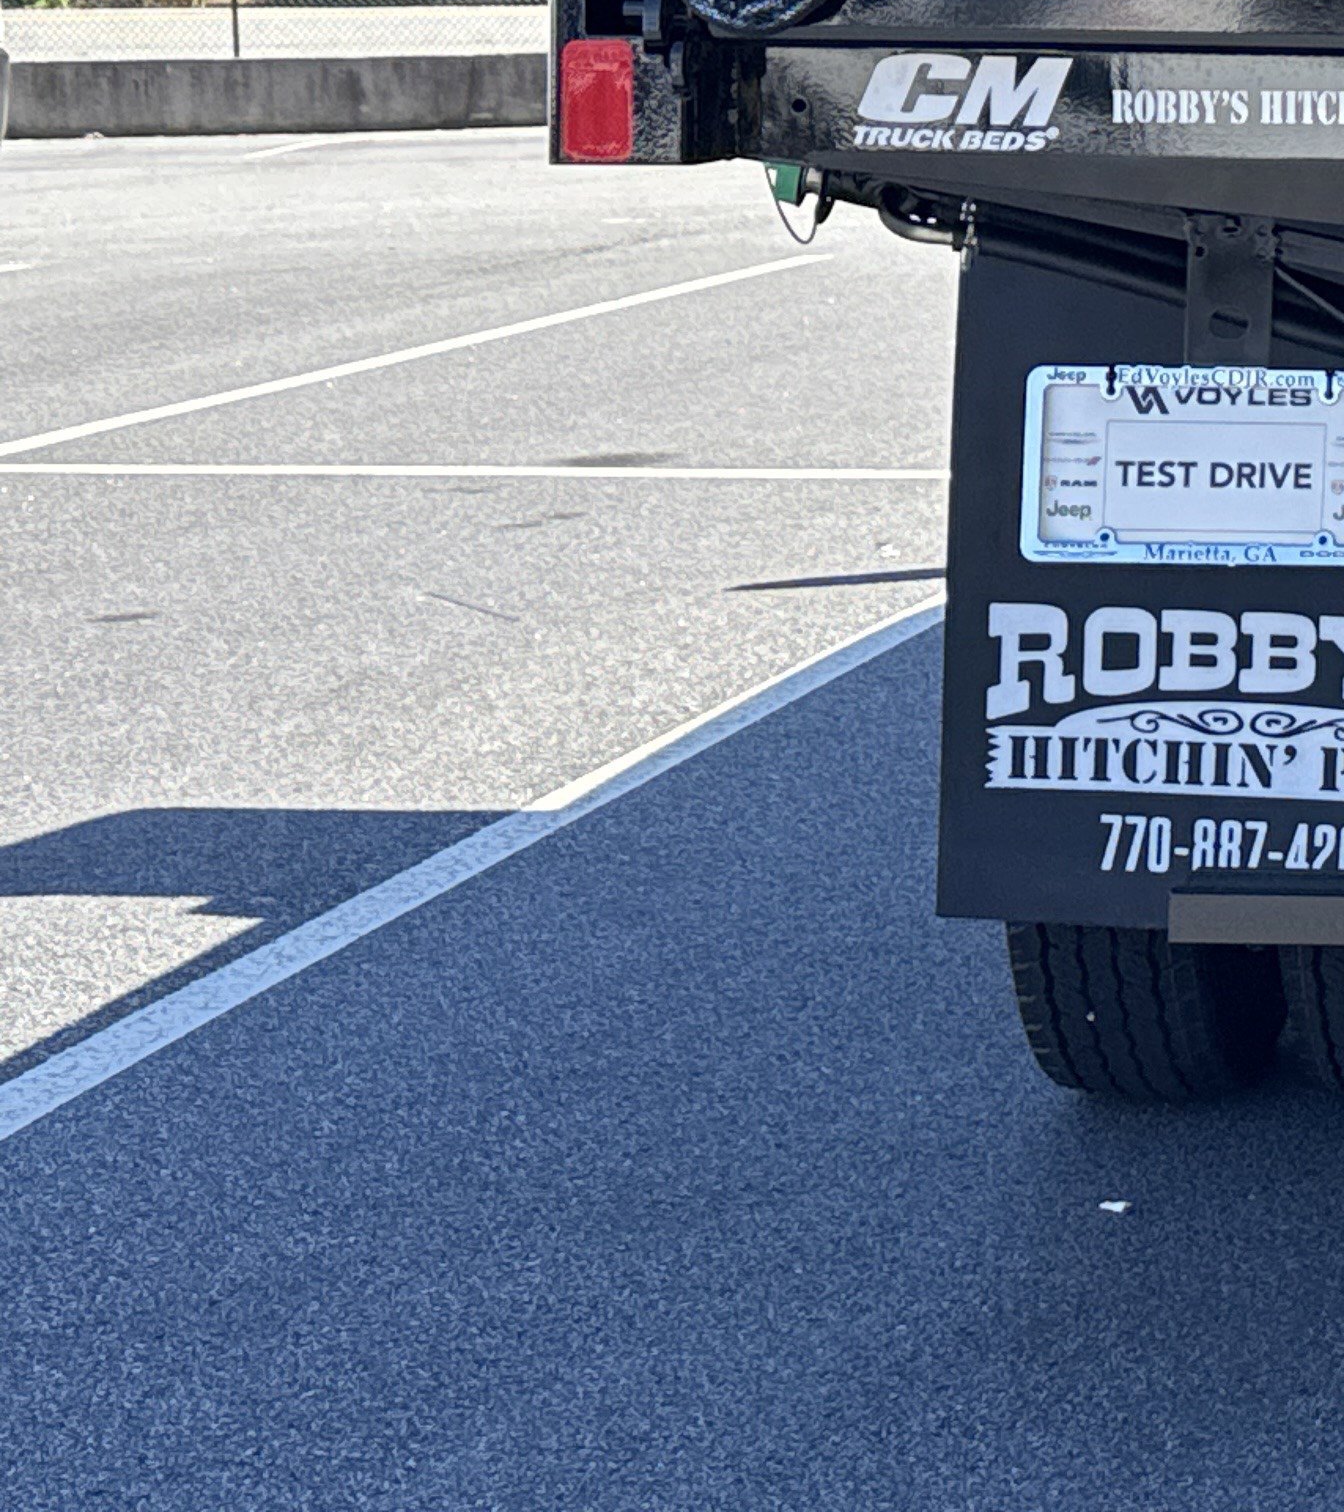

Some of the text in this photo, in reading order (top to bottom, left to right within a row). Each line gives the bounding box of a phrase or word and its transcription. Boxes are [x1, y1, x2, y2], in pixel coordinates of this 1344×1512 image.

[857, 53, 1073, 126] CM
[1112, 89, 1249, 124] ROBBY'S
[853, 125, 956, 149] TRUCK
[1046, 367, 1087, 384] Jeep
[1117, 368, 1315, 390] EdVoylesCDJR.com
[1175, 386, 1312, 407] VOYLES
[1115, 460, 1313, 489] TEST DRIVE
[1046, 500, 1092, 521] Jeep
[1143, 543, 1277, 563] Marietta, GA
[1007, 735, 1298, 788] HITCHIN'
